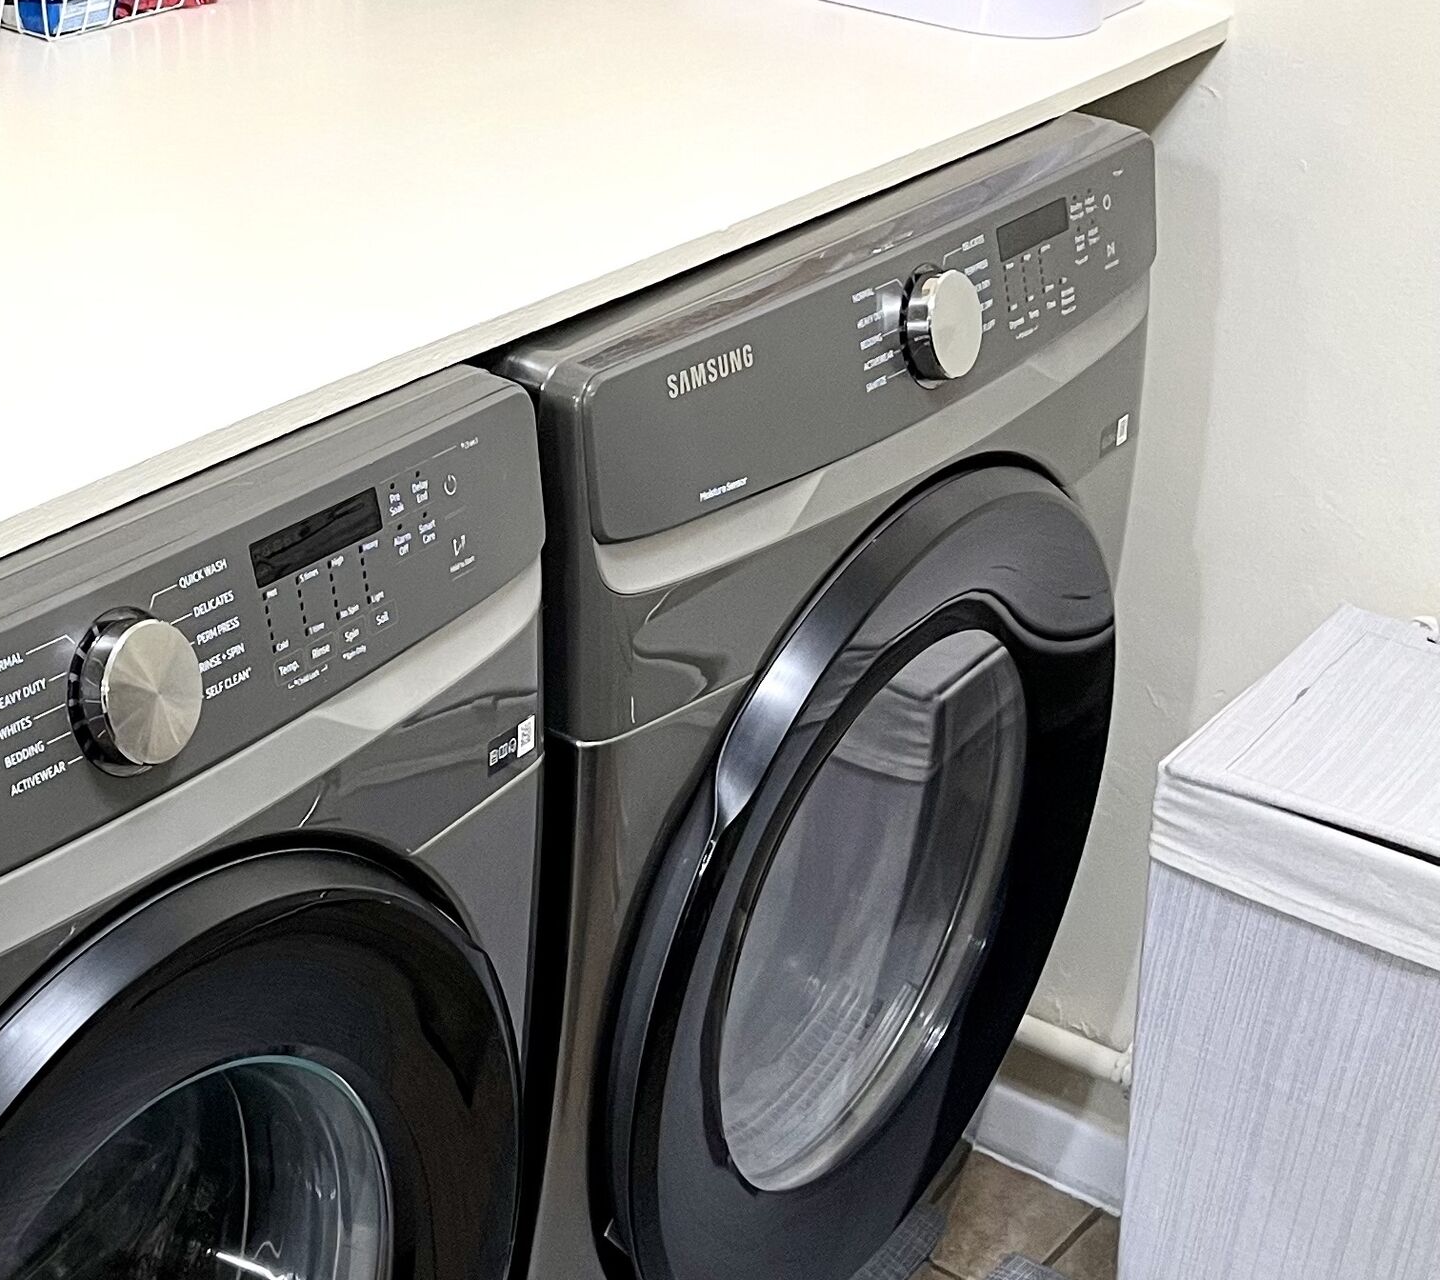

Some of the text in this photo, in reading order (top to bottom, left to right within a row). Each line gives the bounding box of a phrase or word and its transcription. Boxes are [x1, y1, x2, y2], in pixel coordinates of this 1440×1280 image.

[667, 344, 754, 399] SAMSUNG
[178, 558, 228, 589] QUICK WASH
[193, 590, 235, 618] DELICATES
[376, 611, 390, 625] Soil
[196, 616, 240, 646] PERM PRESS
[344, 628, 360, 642] Spin
[199, 653, 222, 674] RINSE
[226, 642, 245, 660] SPIN
[276, 639, 289, 652] Cold
[312, 644, 331, 659] Rinse
[23, 678, 47, 698] DUTY
[205, 681, 223, 700] SELF
[4, 740, 45, 769] BEDDING
[11, 761, 67, 797] ACTIVEWEAR
